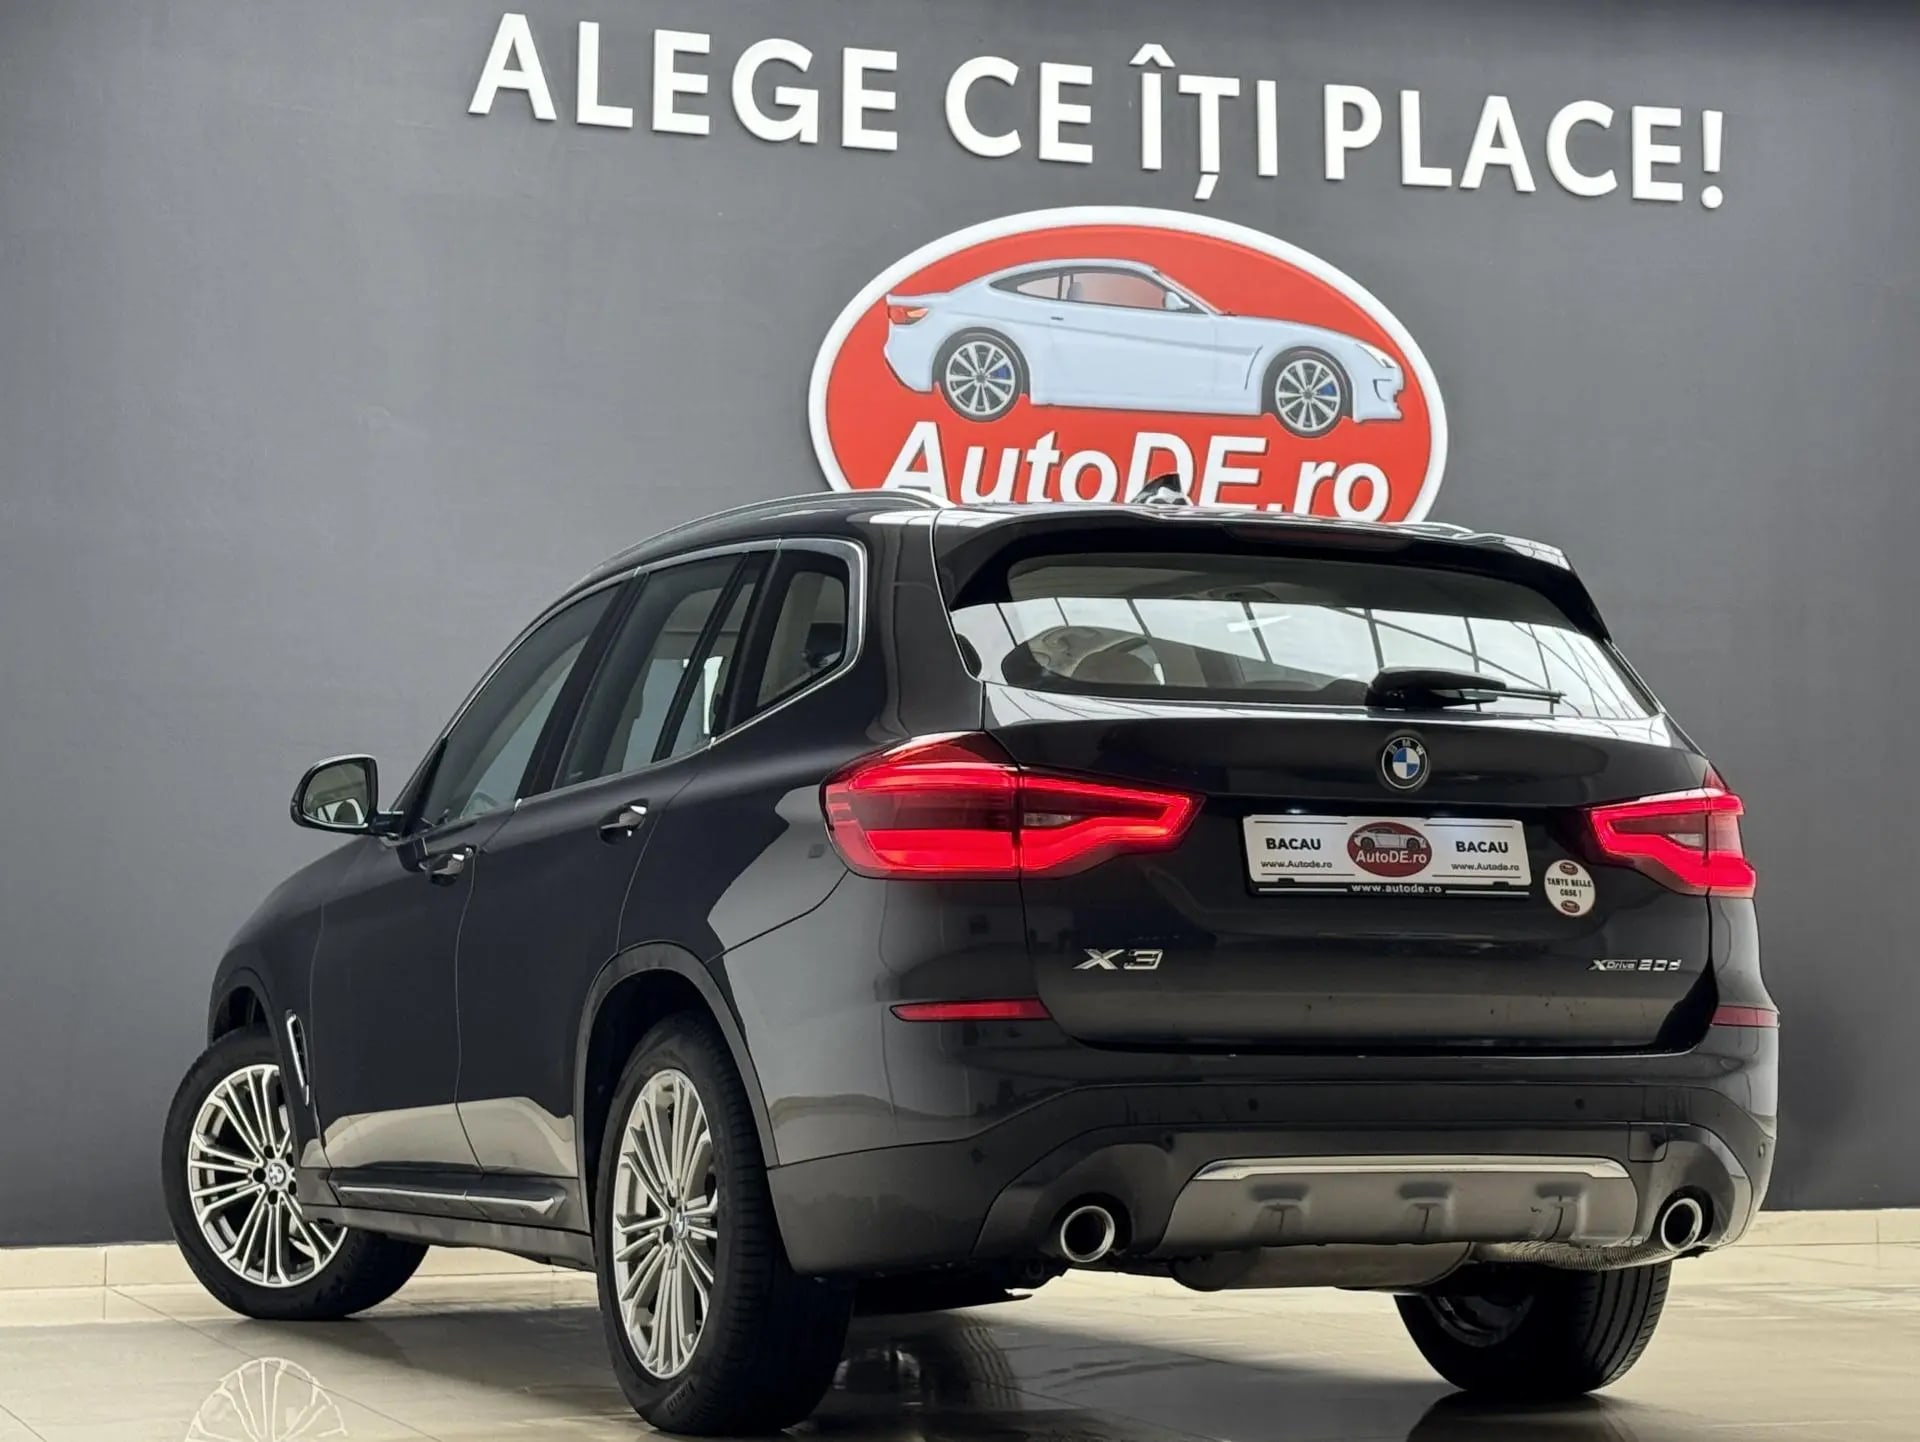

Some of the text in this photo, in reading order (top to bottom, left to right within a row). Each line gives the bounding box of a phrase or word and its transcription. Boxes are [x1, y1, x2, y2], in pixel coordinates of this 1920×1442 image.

[468, 12, 897, 151] ALEGE
[944, 55, 1094, 164] CE
[1324, 83, 1724, 209] PLACE!
[880, 420, 1391, 522] AutoDE.ro
[1387, 739, 1425, 755] BMW
[1265, 837, 1322, 850] BACAU
[1455, 840, 1509, 854] BACAU
[1356, 850, 1427, 864] AutoDE.ro
[1260, 860, 1333, 869] www.Autode.ro
[1451, 862, 1520, 871] www.Autode.ro
[1351, 883, 1442, 894] www.autode.ro
[1072, 948, 1163, 970] X3
[1638, 959, 1682, 971] 20d
